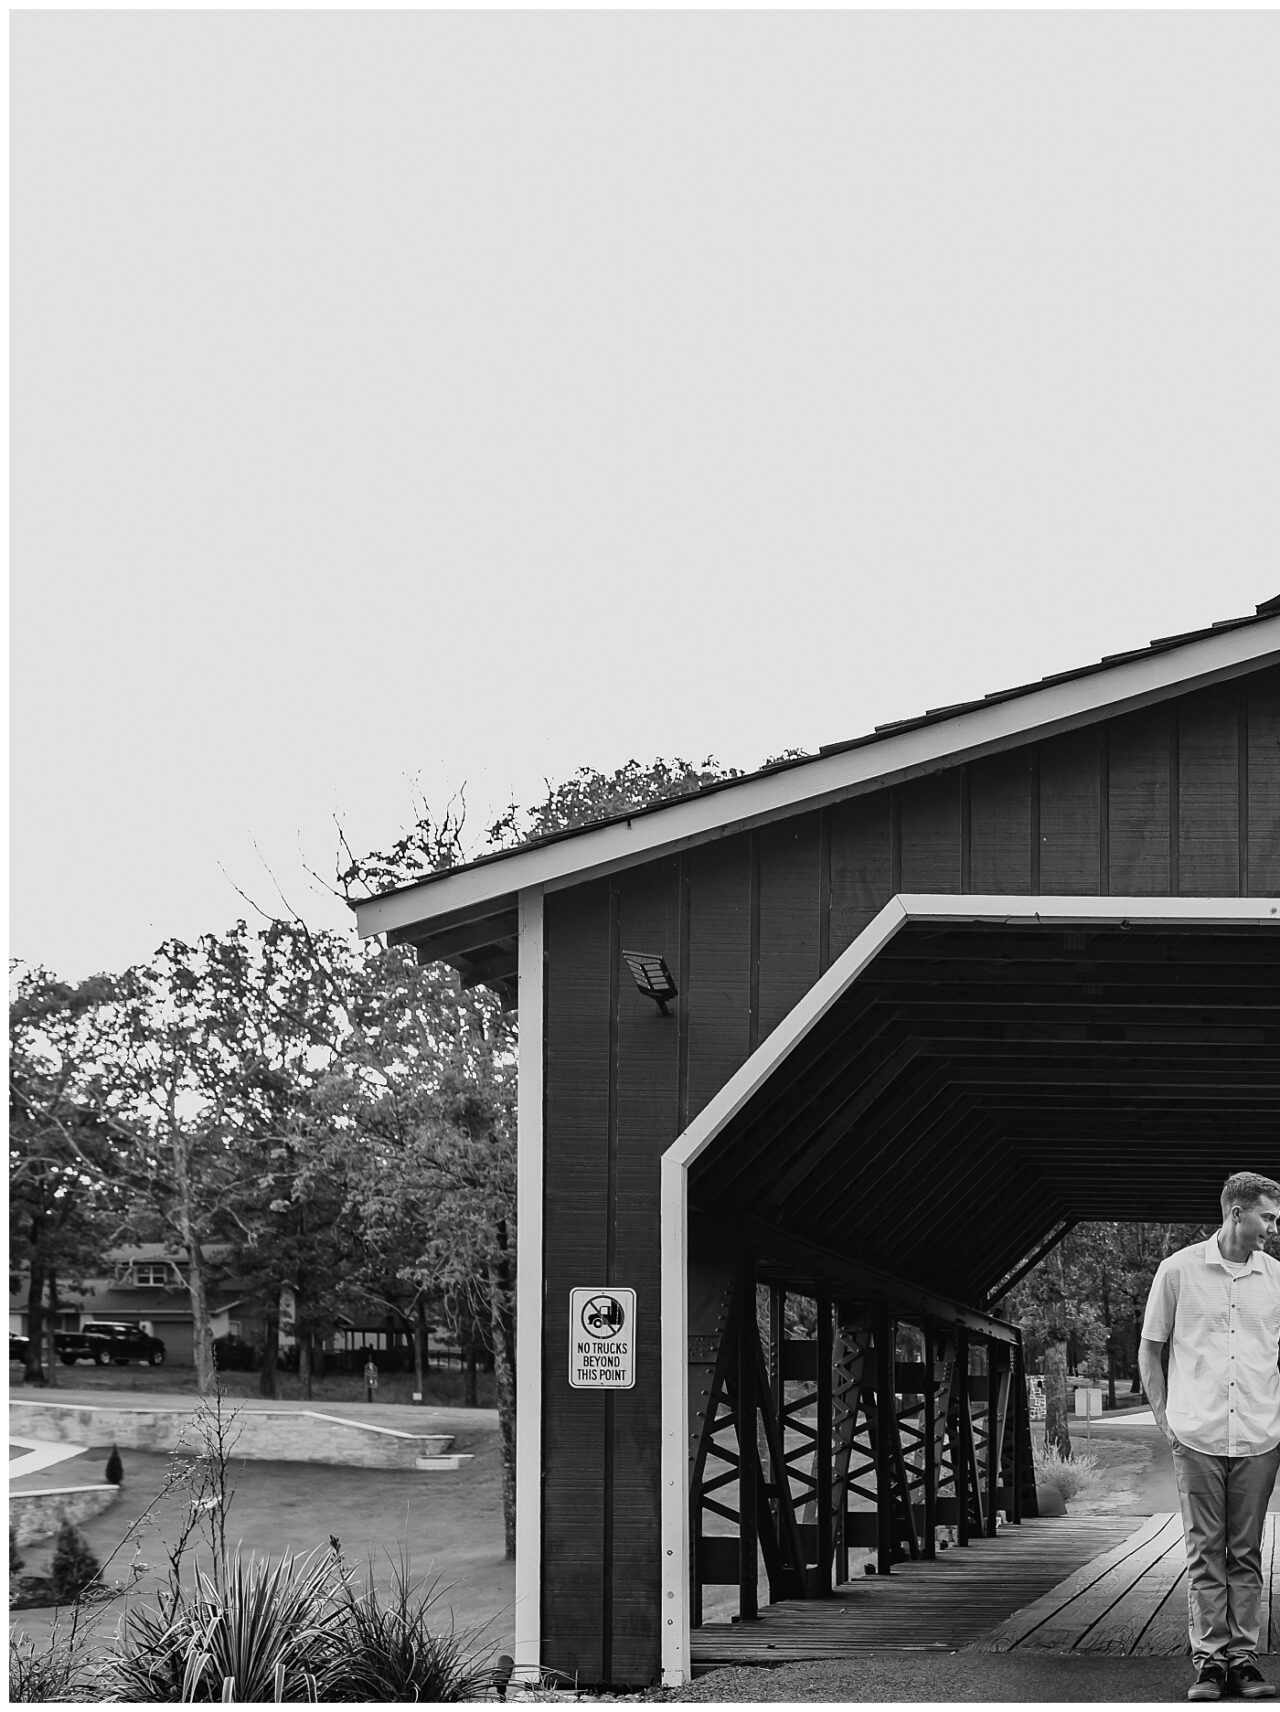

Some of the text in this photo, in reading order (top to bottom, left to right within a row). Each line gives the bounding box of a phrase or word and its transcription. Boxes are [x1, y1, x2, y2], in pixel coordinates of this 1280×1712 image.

[577, 1342, 628, 1354] NO TRUCKS
[583, 1356, 620, 1367] BEYOND
[577, 1369, 626, 1381] THIS POINT
